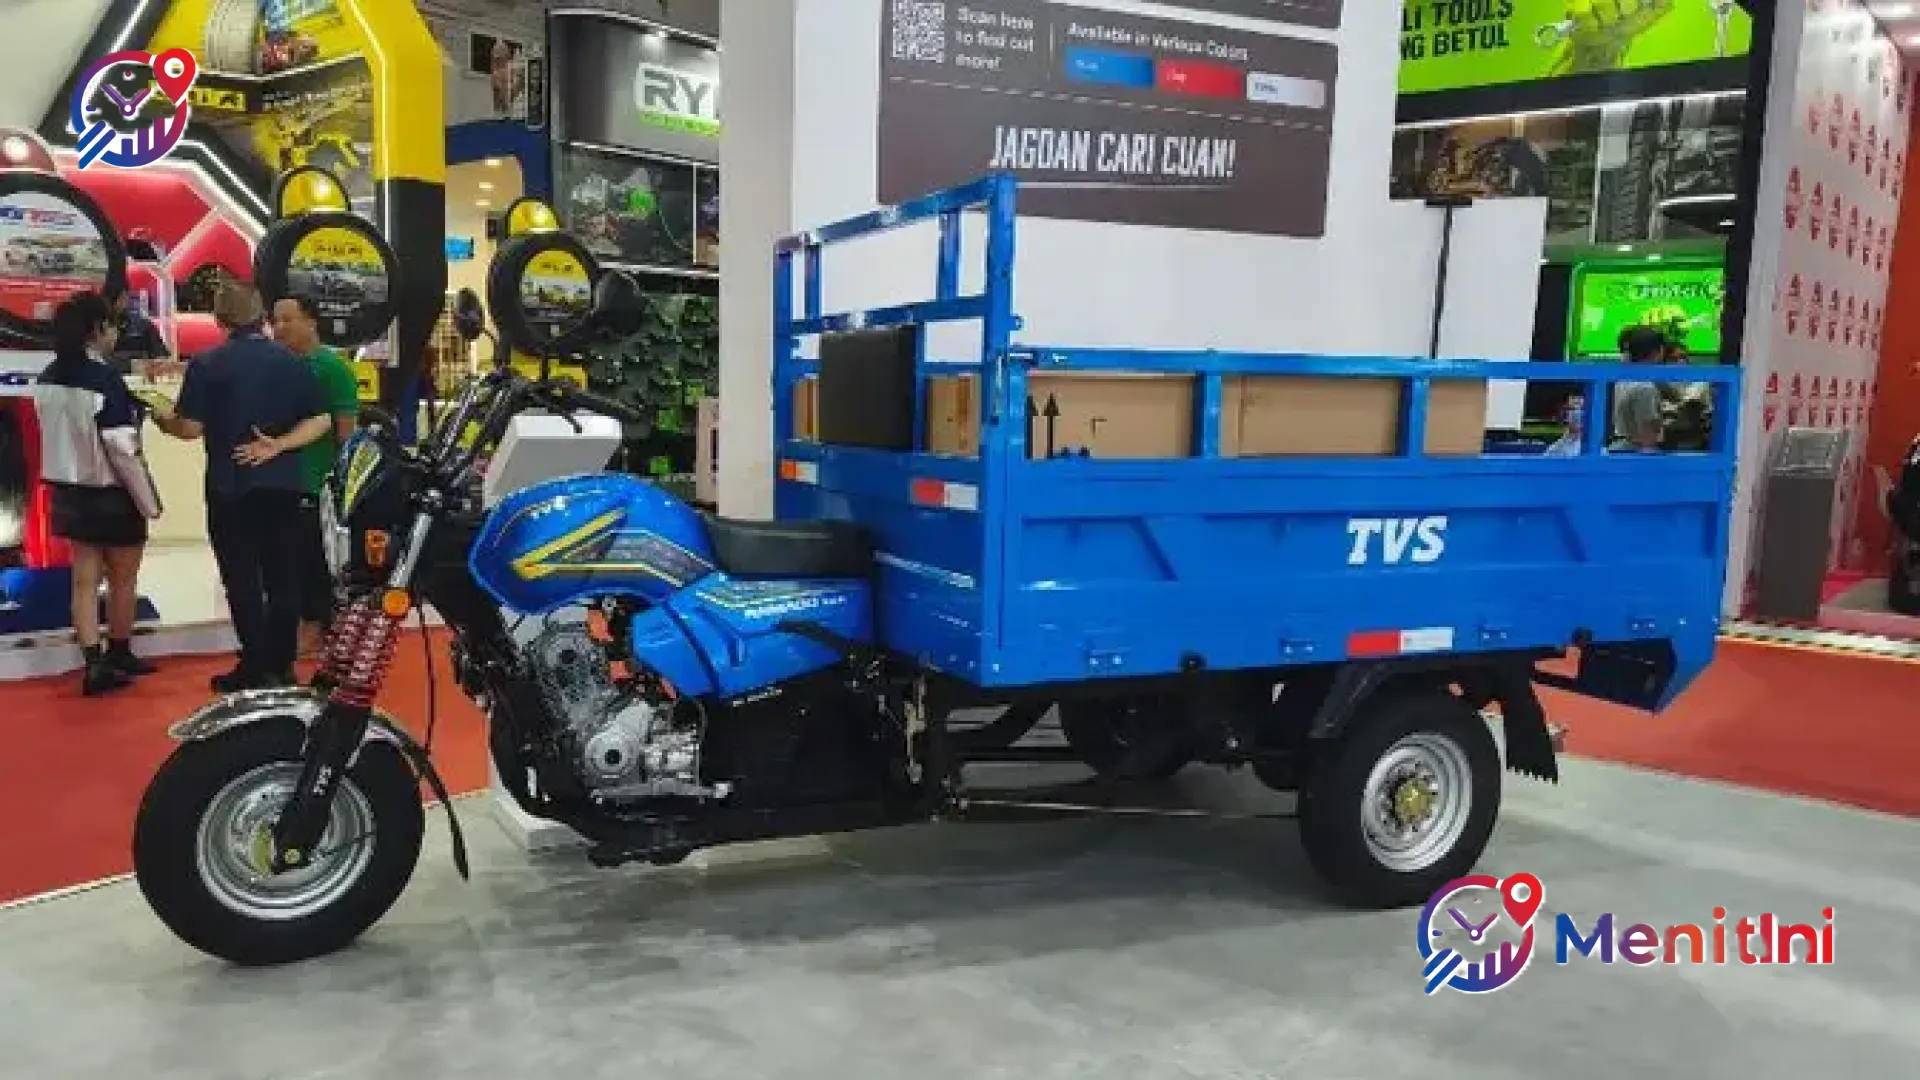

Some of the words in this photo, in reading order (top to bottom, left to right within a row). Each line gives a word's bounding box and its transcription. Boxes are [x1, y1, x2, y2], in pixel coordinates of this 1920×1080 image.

[957, 7, 996, 25] Scan
[1432, 0, 1513, 26] TOOLS
[955, 30, 973, 46] to
[1009, 36, 1034, 52] out
[1067, 21, 1131, 45] Available
[1206, 39, 1248, 60] Colors
[1433, 22, 1509, 57] BETUL
[989, 124, 1091, 171] JAGOAN
[1097, 130, 1157, 175] CARI
[1161, 135, 1236, 178] CUAN!
[1346, 515, 1448, 565] TVS
